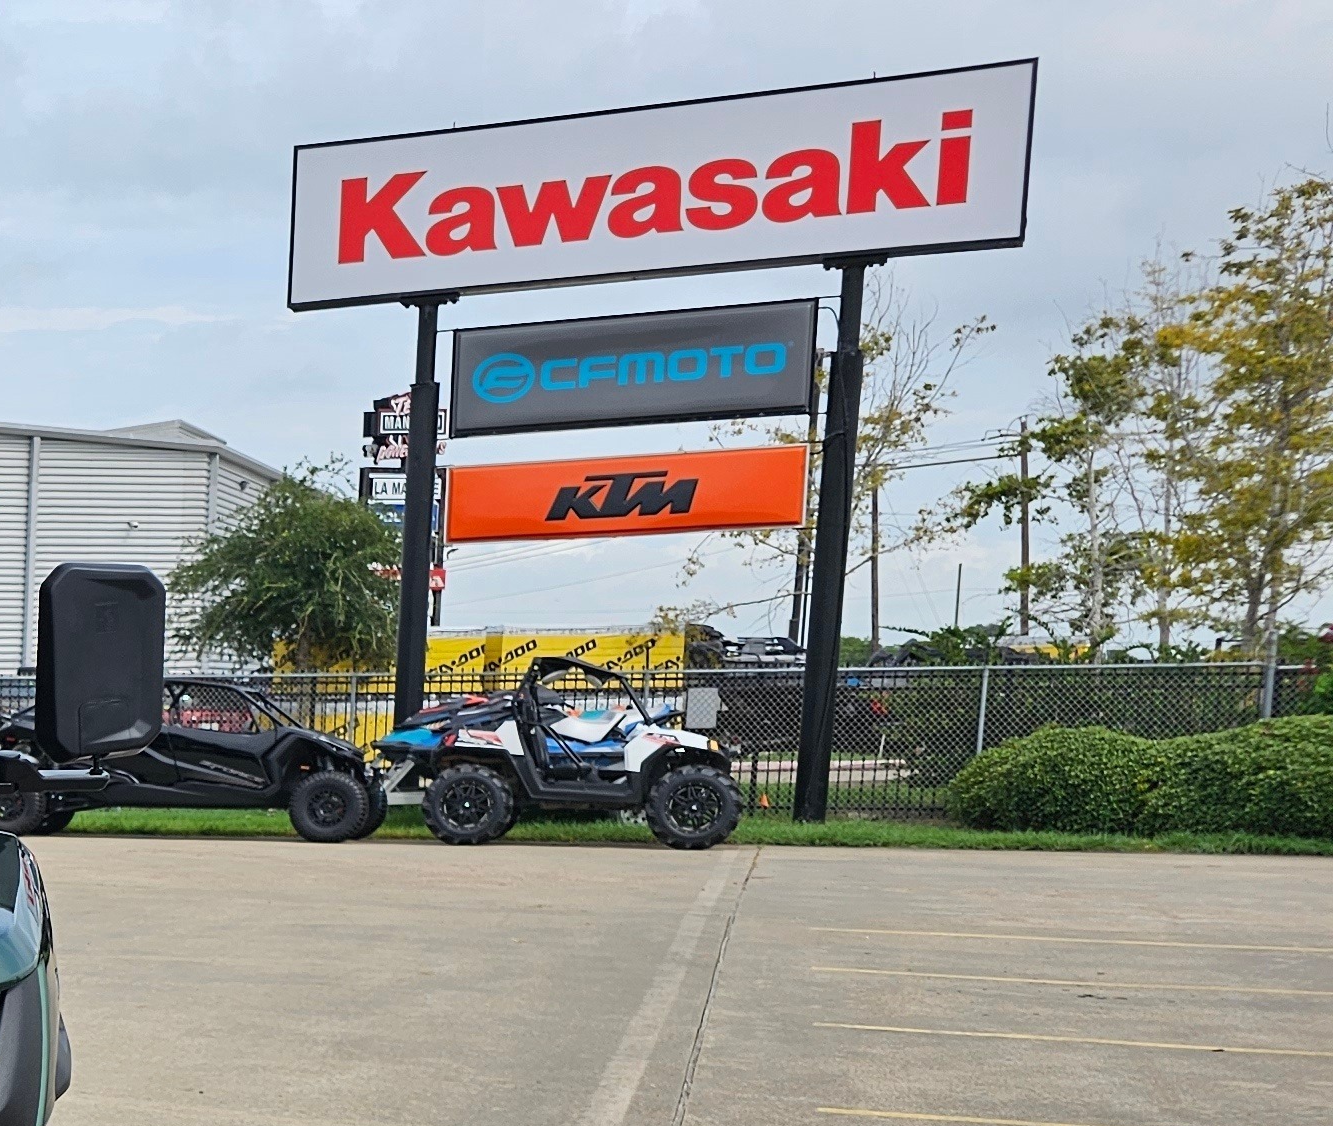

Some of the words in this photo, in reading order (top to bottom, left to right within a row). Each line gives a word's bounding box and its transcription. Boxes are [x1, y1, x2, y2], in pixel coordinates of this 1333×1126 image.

[337, 109, 973, 264] Kawasaki
[540, 342, 787, 391] CFMOTO
[545, 470, 699, 521] KTM
